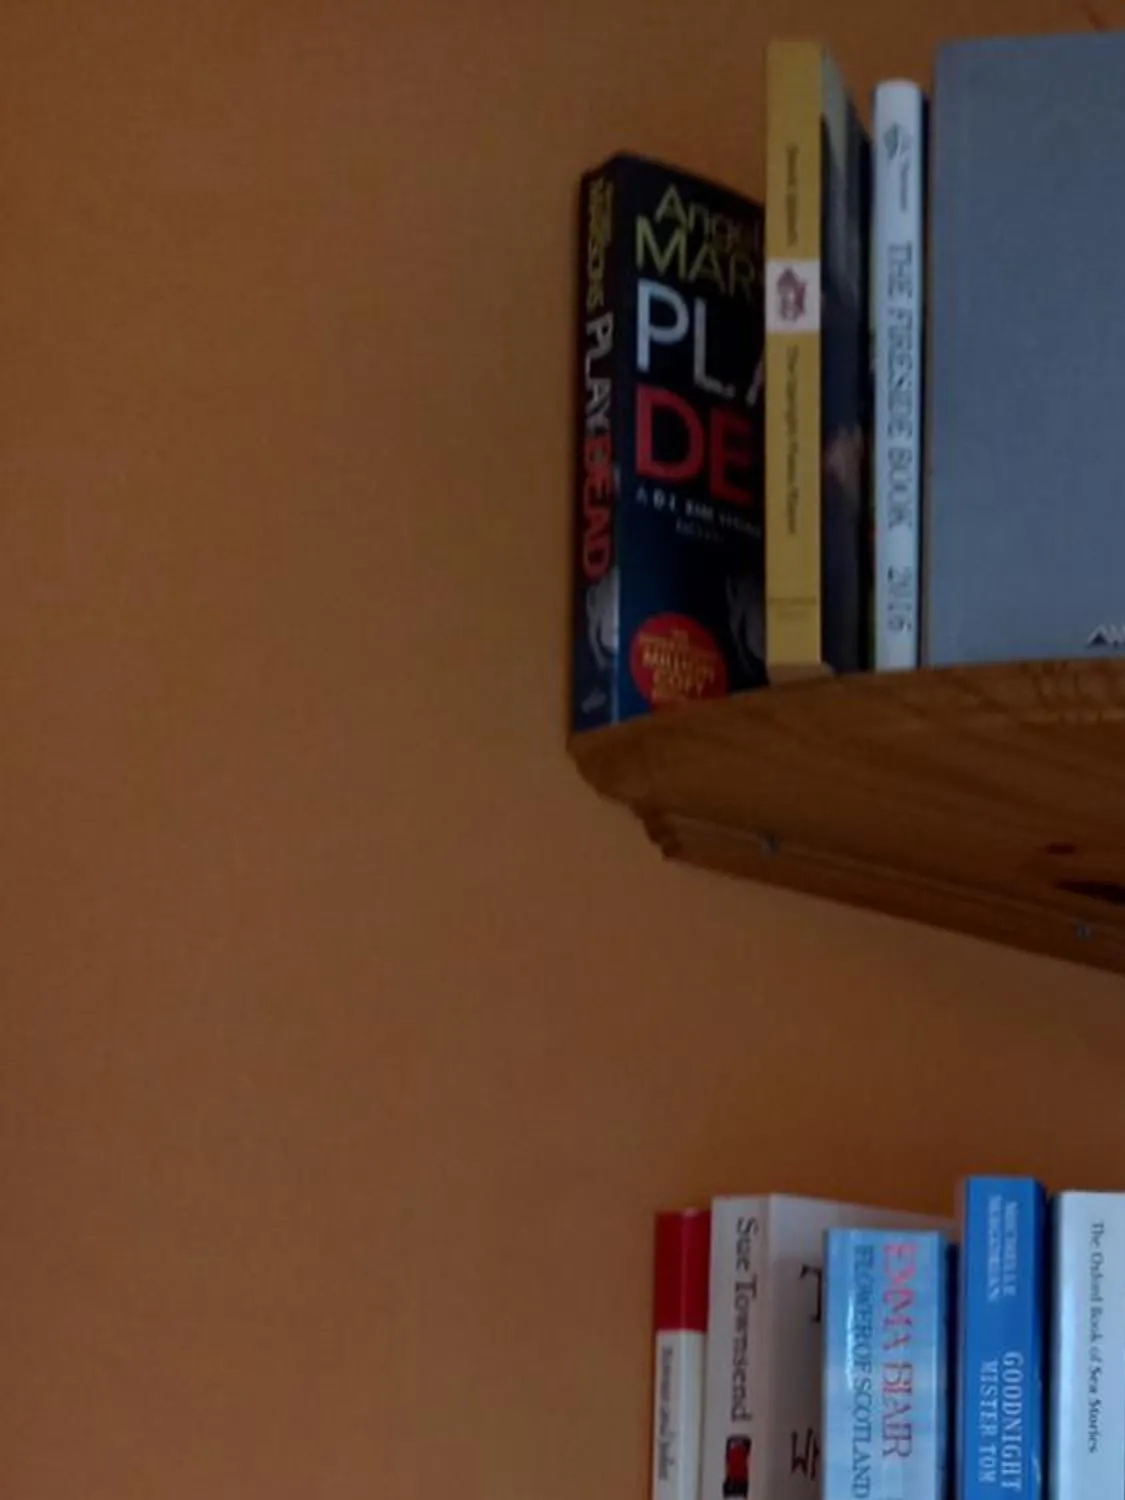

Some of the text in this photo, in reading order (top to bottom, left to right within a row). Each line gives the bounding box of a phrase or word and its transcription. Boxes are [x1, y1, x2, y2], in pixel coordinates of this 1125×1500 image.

[886, 240, 911, 298] THE
[584, 311, 613, 433] PLAY
[886, 305, 912, 438] FIRESIDE
[582, 431, 611, 578] DEAD
[886, 446, 912, 528] BOOK
[731, 1216, 759, 1424] Sue Townsend
[850, 1244, 875, 1500] FLOWER OF SCOTLAND
[881, 1241, 917, 1461] EMMA BLAIR
[1087, 1220, 1105, 1455] The Oxford Book of Sea Stories
[977, 1359, 999, 1484] MISTER TOM
[1000, 1351, 1025, 1493] GOODNIGHT
